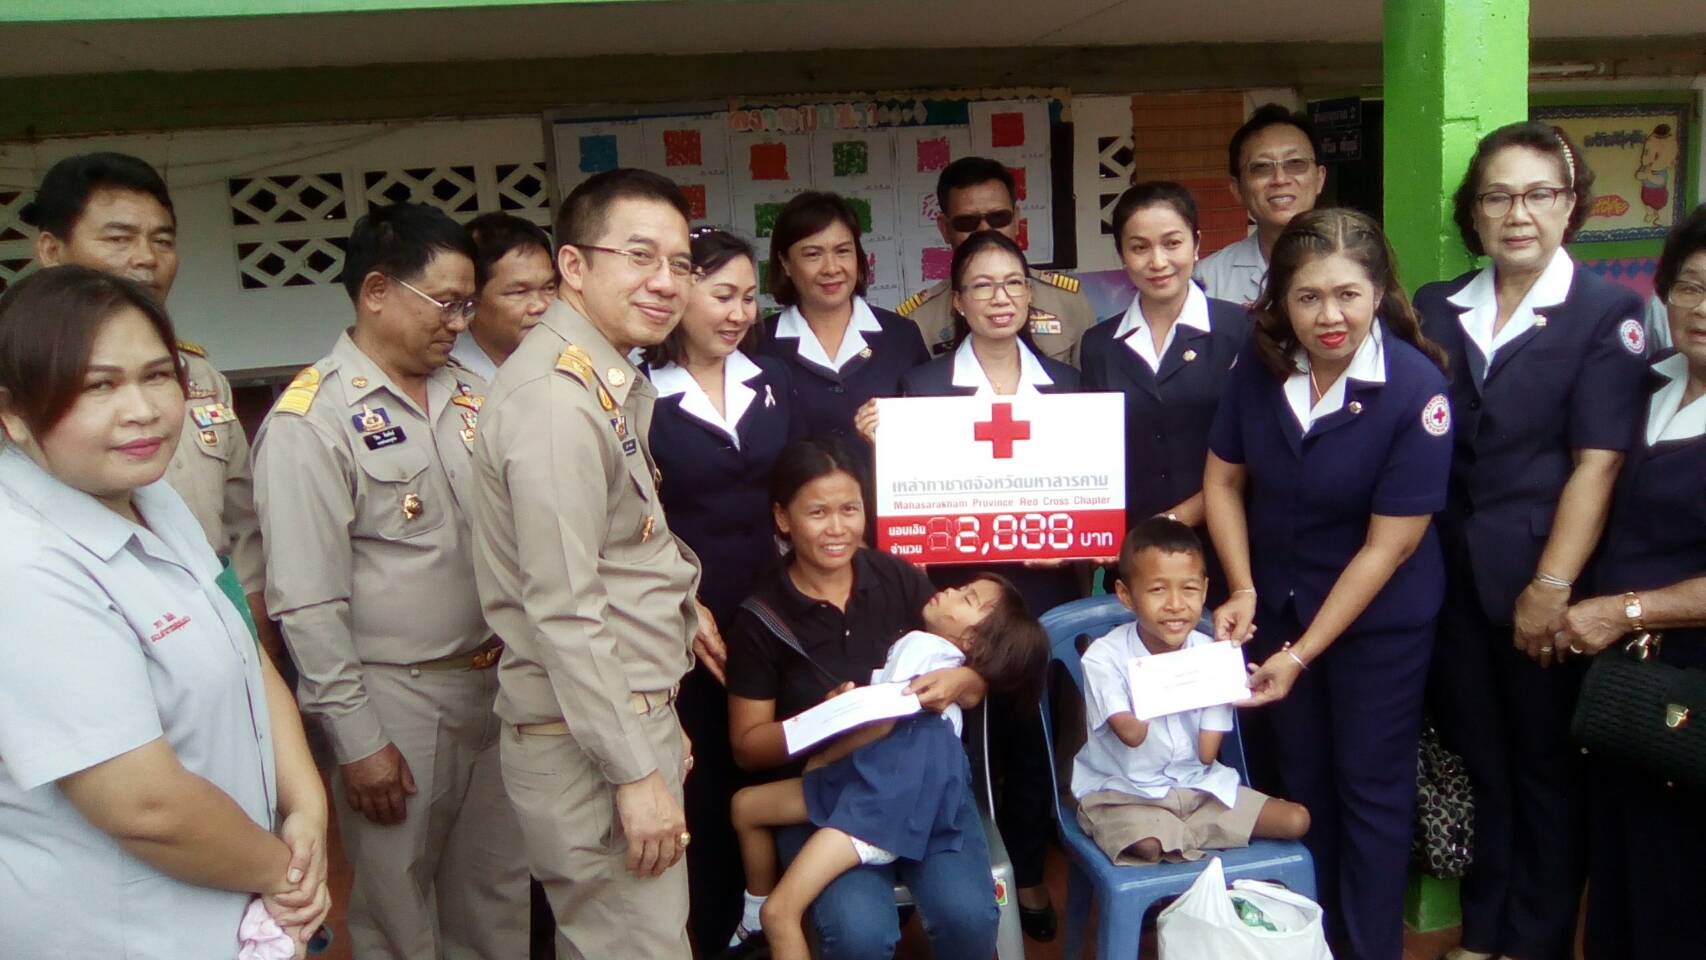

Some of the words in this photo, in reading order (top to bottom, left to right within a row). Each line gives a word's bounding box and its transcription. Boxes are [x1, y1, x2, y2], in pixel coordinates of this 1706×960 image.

[892, 474, 1109, 493] เหล่ากาชาดจังหวัดมหาสารคาม
[893, 500, 968, 510] Mahasarakham
[972, 498, 1014, 508] Province
[1019, 497, 1039, 506] Red
[1042, 496, 1069, 506] Cross
[1073, 495, 1111, 506] Chapter
[1080, 531, 1114, 547] บาท
[890, 543, 923, 555] จำนวน
